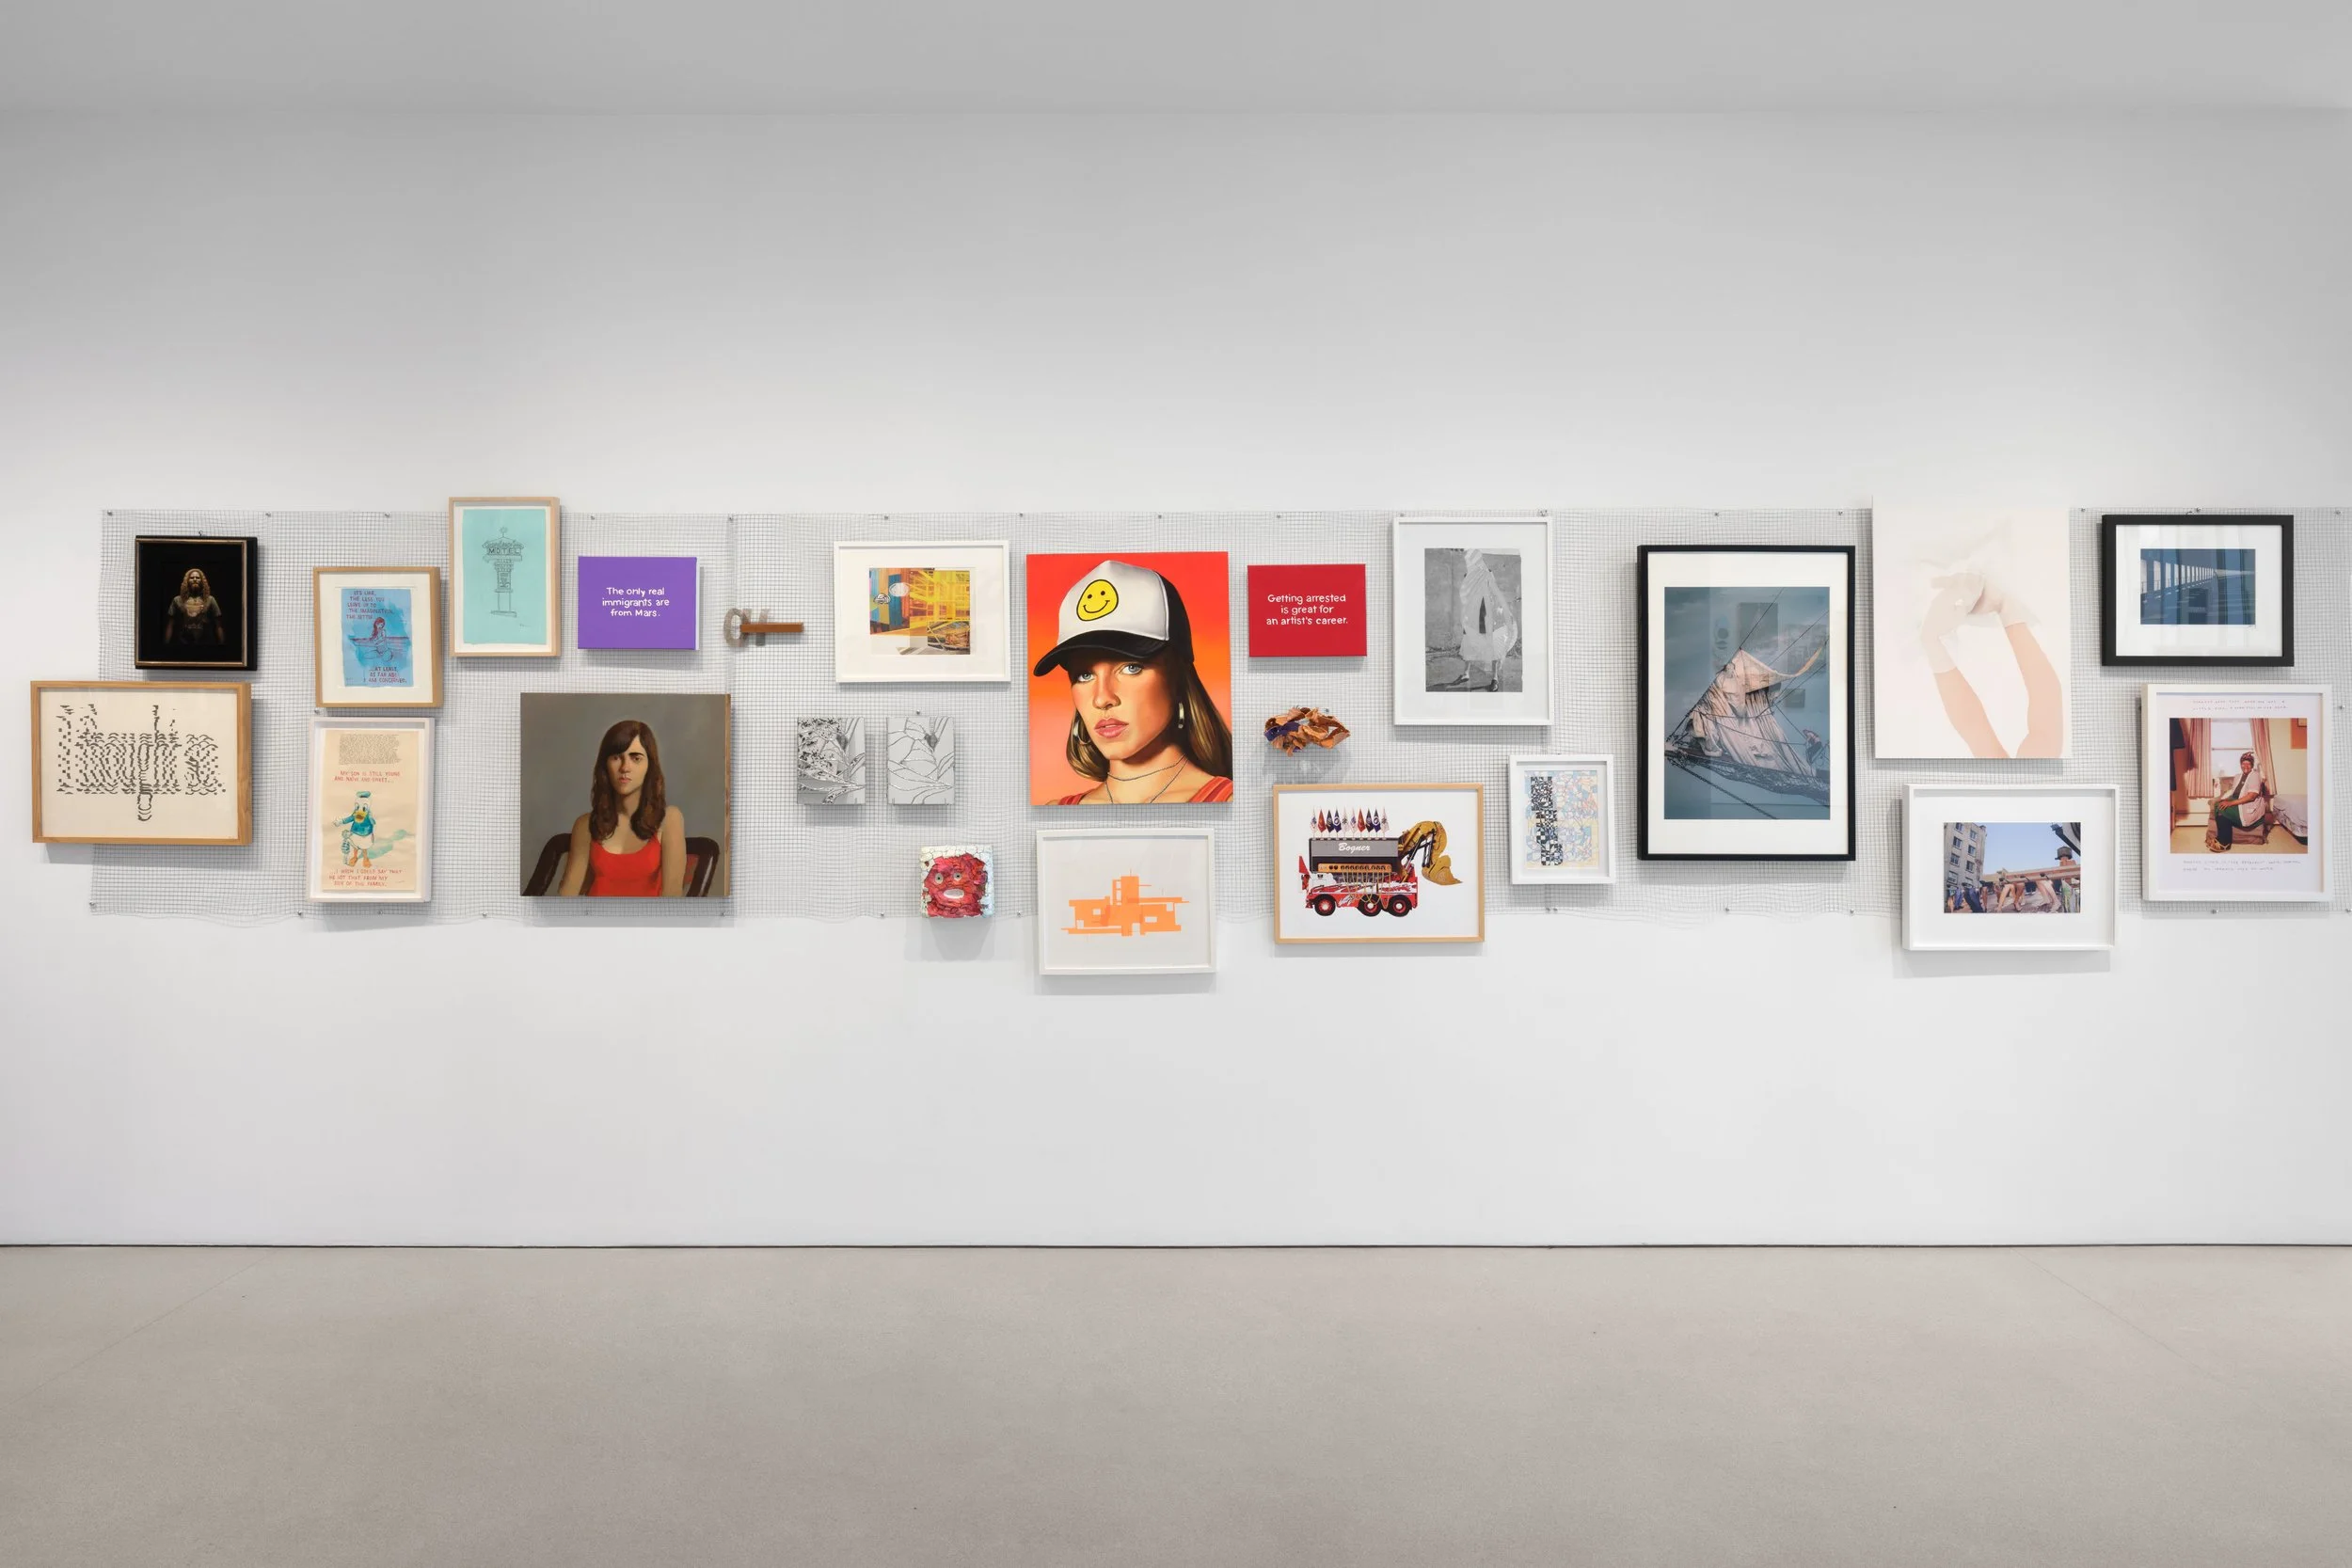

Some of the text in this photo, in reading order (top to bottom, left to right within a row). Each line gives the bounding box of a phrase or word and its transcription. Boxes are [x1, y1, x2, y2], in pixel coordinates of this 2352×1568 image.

[606, 587, 665, 597] The only real
[602, 597, 652, 608] immigrants
[1267, 594, 1346, 605] Getting arrested
[611, 609, 632, 617] from
[1280, 605, 1334, 615] is great for
[1266, 616, 1348, 626] an artist's career.
[1338, 842, 1371, 854] Bogner
